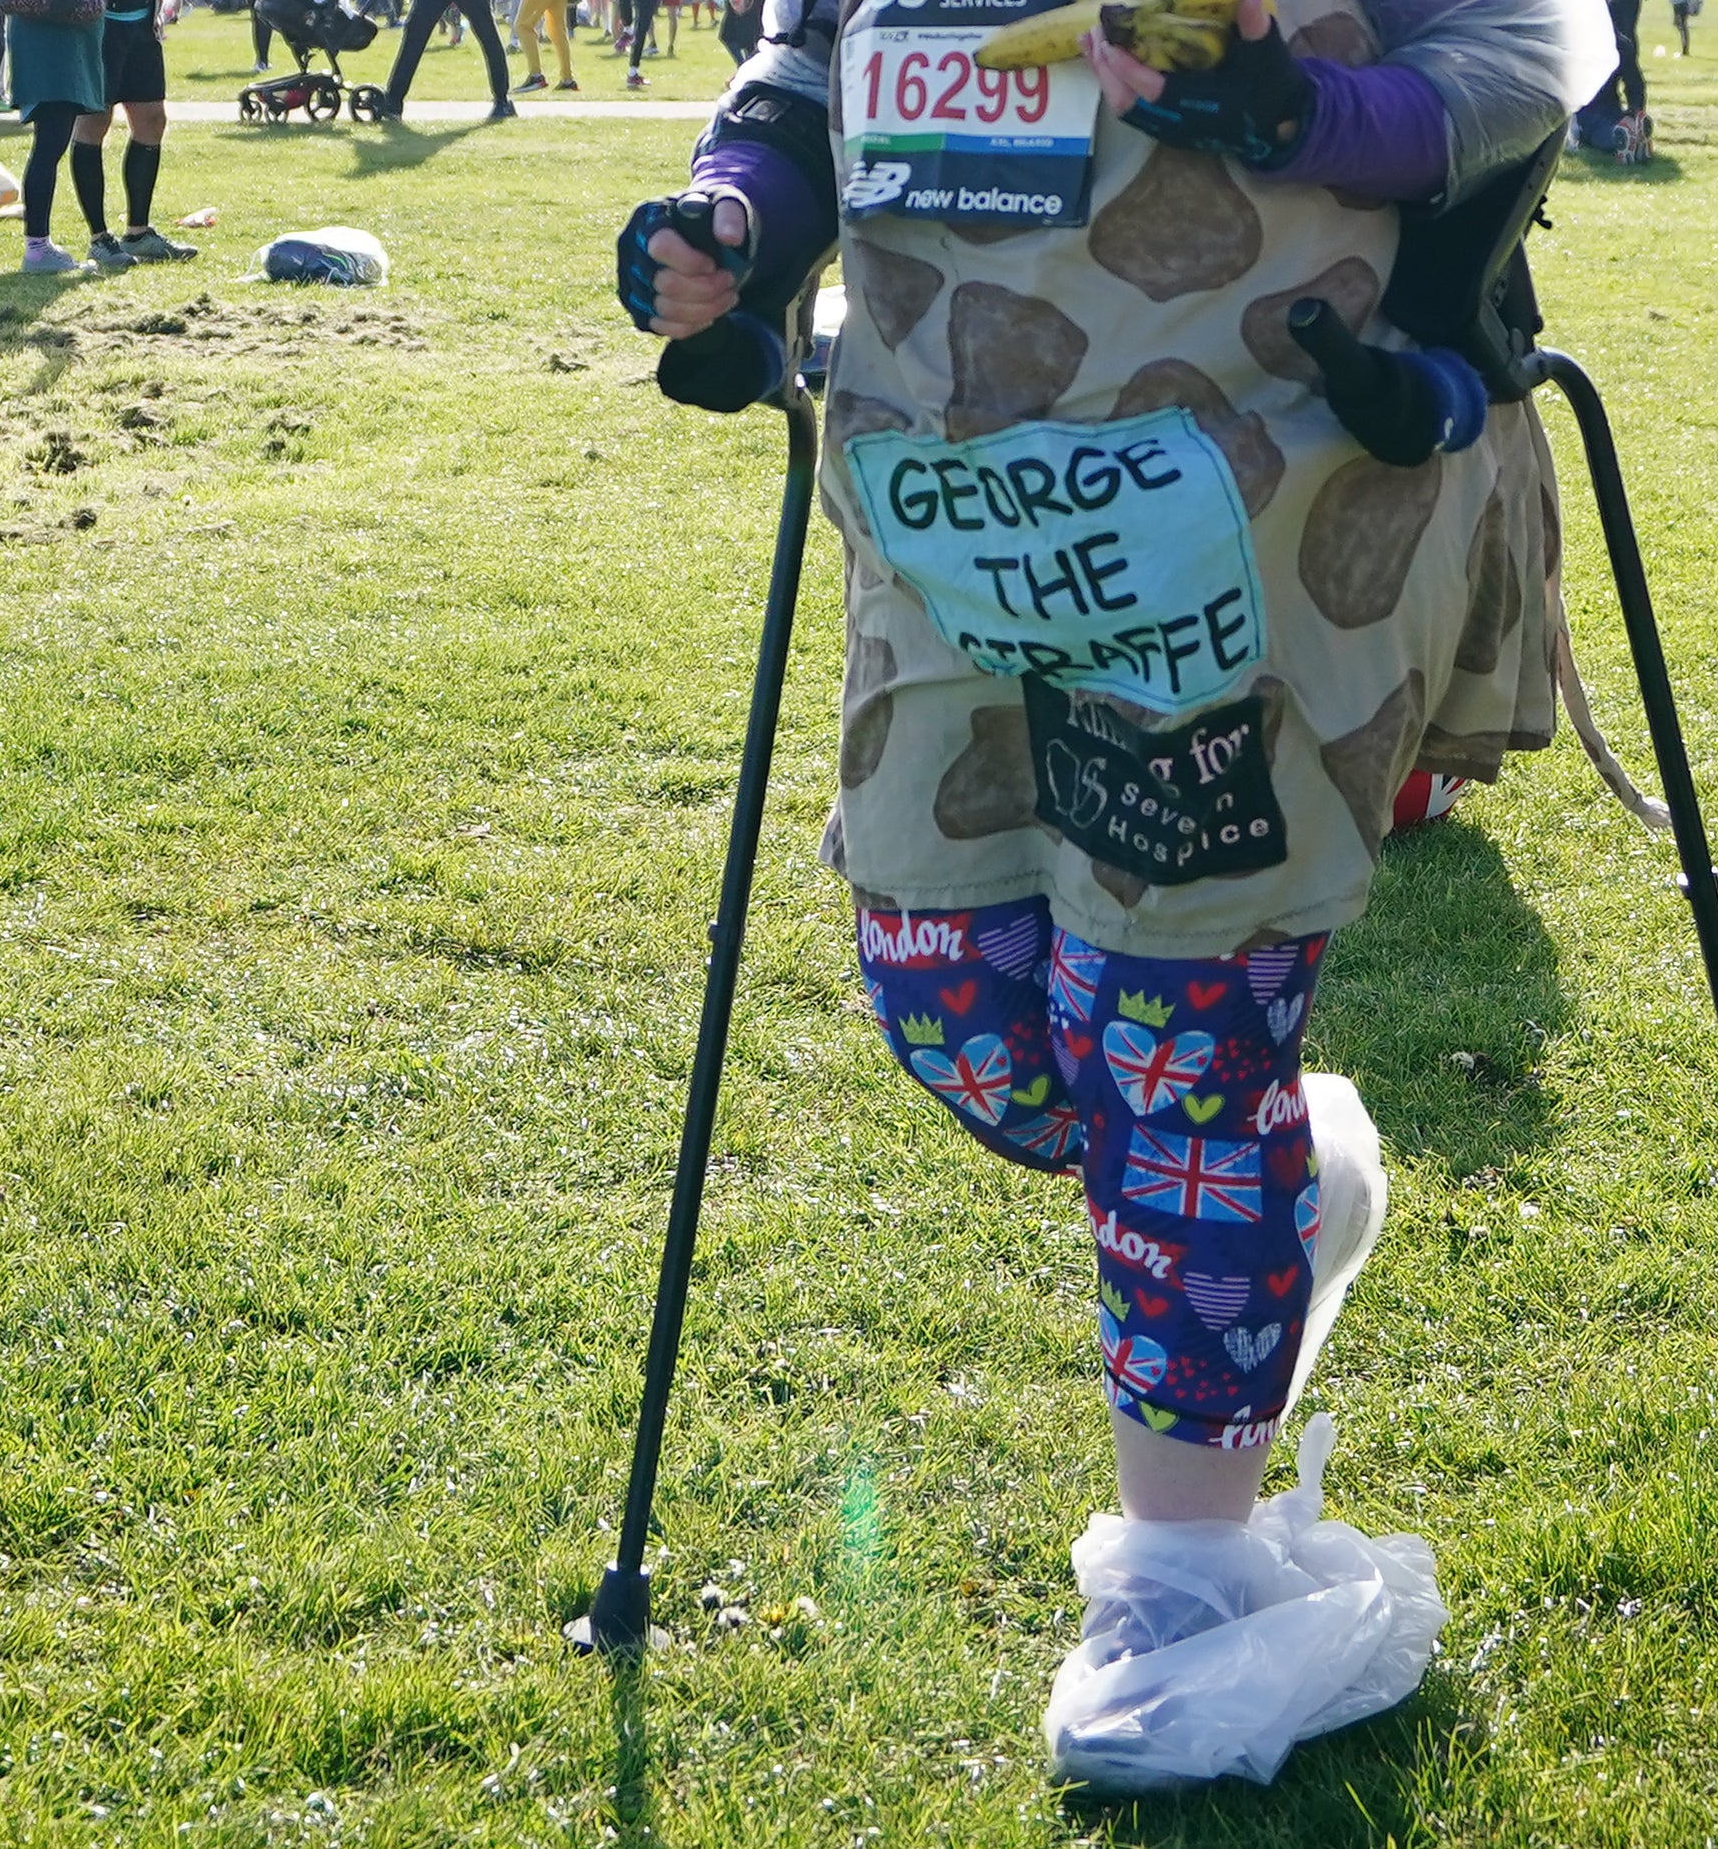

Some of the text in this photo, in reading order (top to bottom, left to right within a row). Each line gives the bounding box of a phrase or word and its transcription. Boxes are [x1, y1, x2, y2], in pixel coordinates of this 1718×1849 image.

[863, 50, 1050, 123] 16299
[905, 186, 1063, 215] new balance
[888, 439, 1183, 530] GEORGE
[974, 533, 1138, 621] THE
[1189, 724, 1250, 784] for
